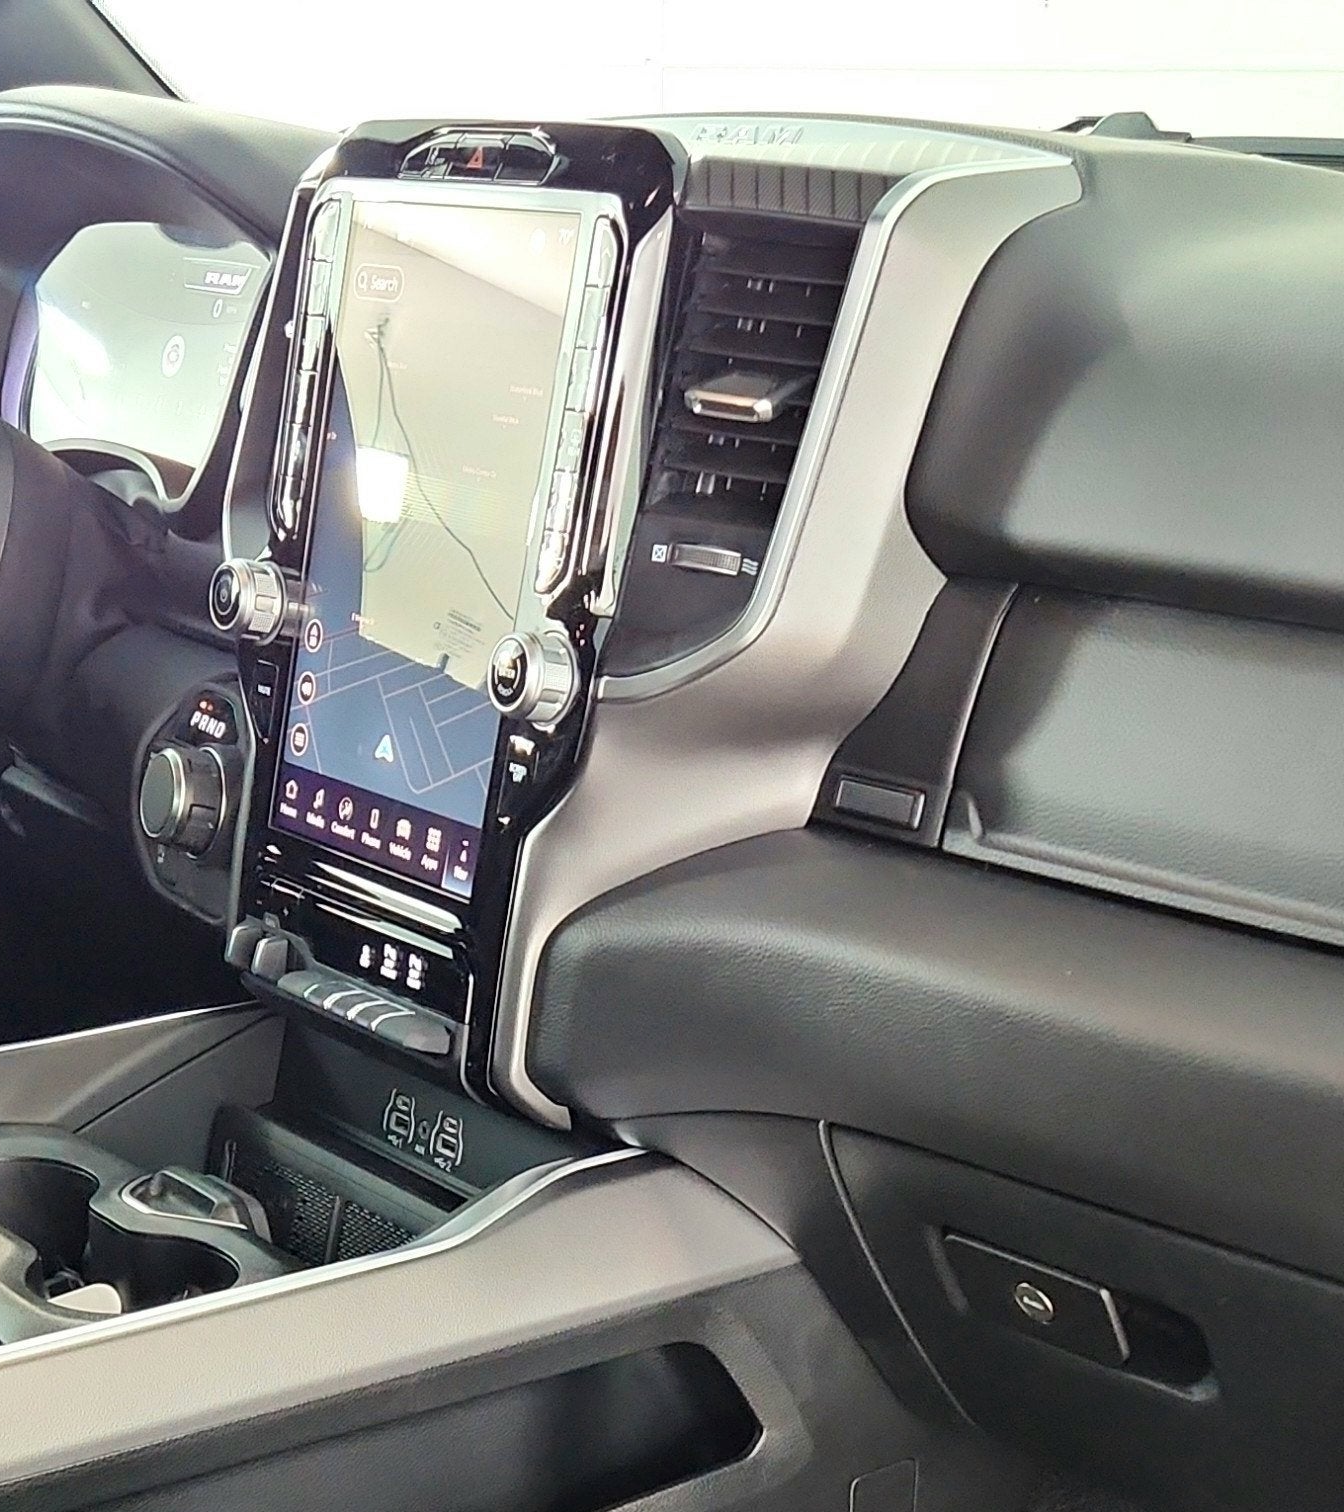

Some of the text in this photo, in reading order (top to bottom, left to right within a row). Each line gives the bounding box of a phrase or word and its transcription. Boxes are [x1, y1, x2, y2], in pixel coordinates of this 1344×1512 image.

[371, 270, 398, 292] Search
[190, 711, 226, 739] PRND
[331, 821, 356, 840] Comfort
[421, 854, 439, 871] Apps
